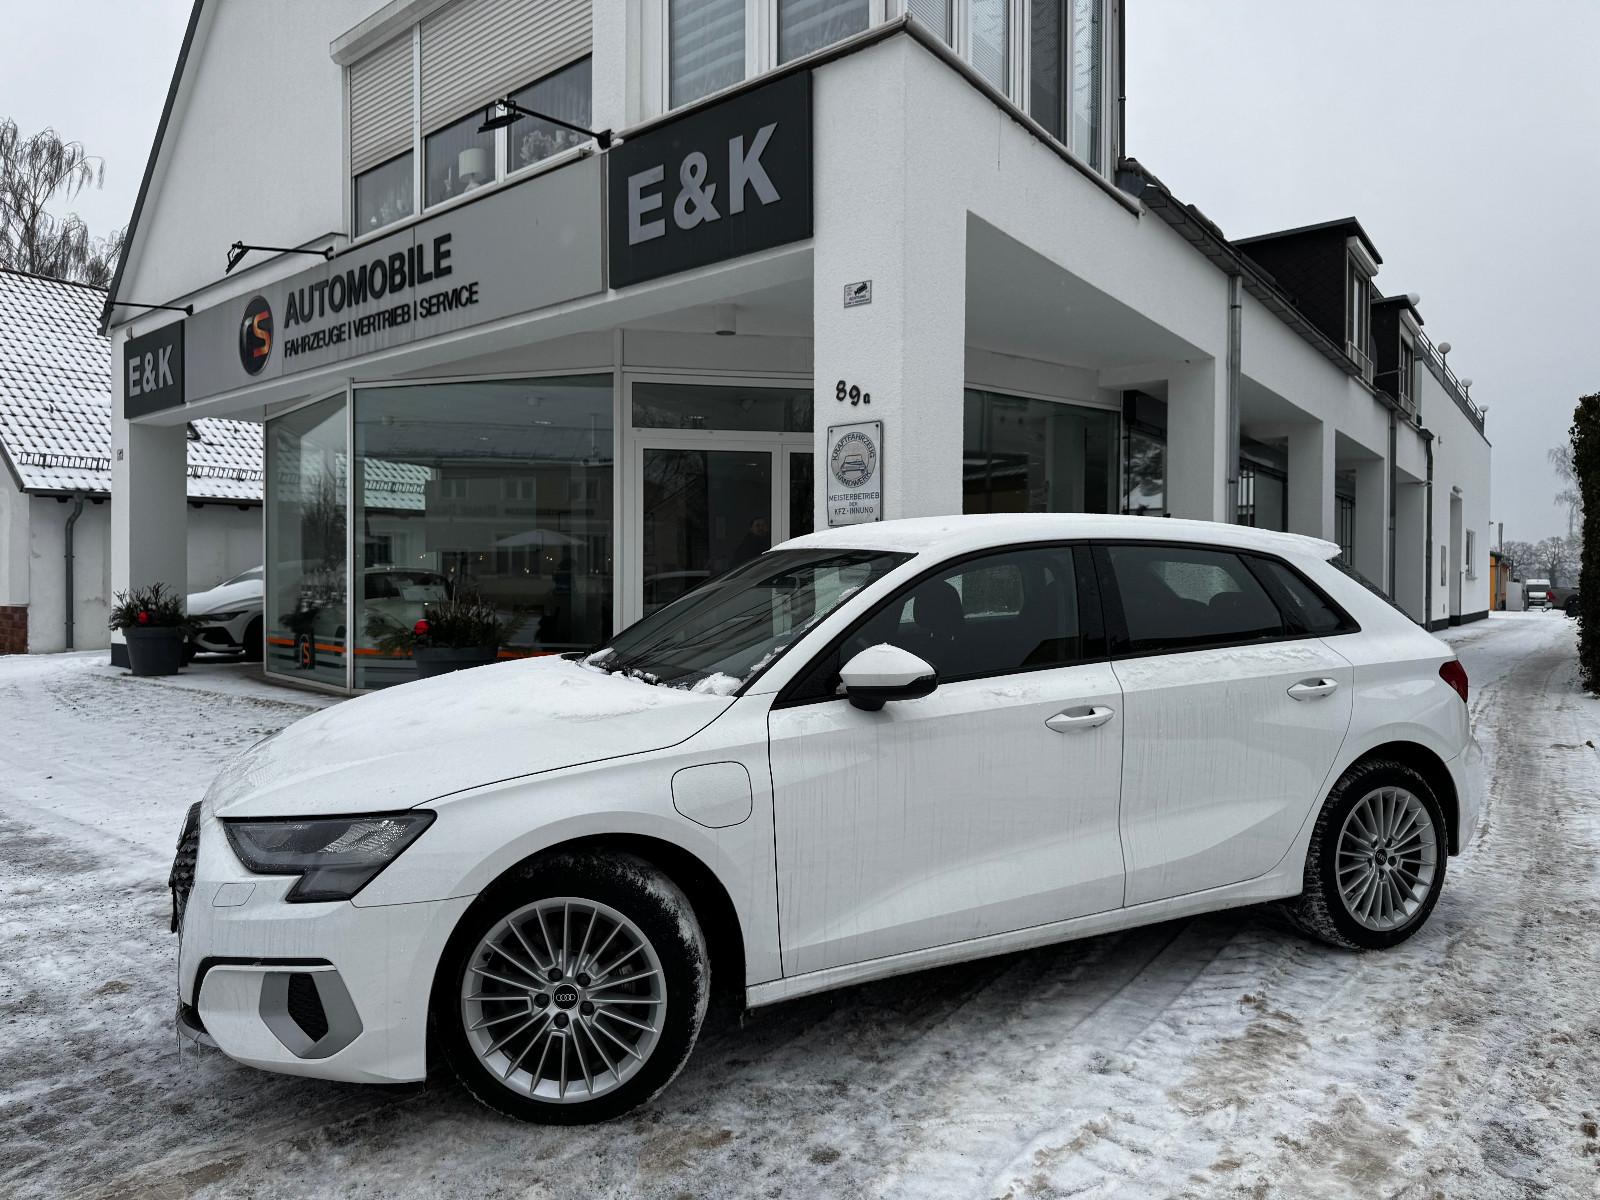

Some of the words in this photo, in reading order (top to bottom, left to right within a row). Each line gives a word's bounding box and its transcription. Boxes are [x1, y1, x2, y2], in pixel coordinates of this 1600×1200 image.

[627, 121, 782, 246] E&K
[283, 232, 453, 329] AUTOMOBILE
[284, 322, 347, 358] FAHRZEUGE
[353, 303, 412, 339] VERTRIEB
[419, 281, 479, 319] SERVICE
[128, 344, 174, 397] E&K
[836, 379, 871, 406] 89a
[831, 433, 875, 461] KRAFTFAHRZEUG
[828, 491, 880, 502] MEISTERBETRIEB
[835, 471, 872, 487] HANDWERK
